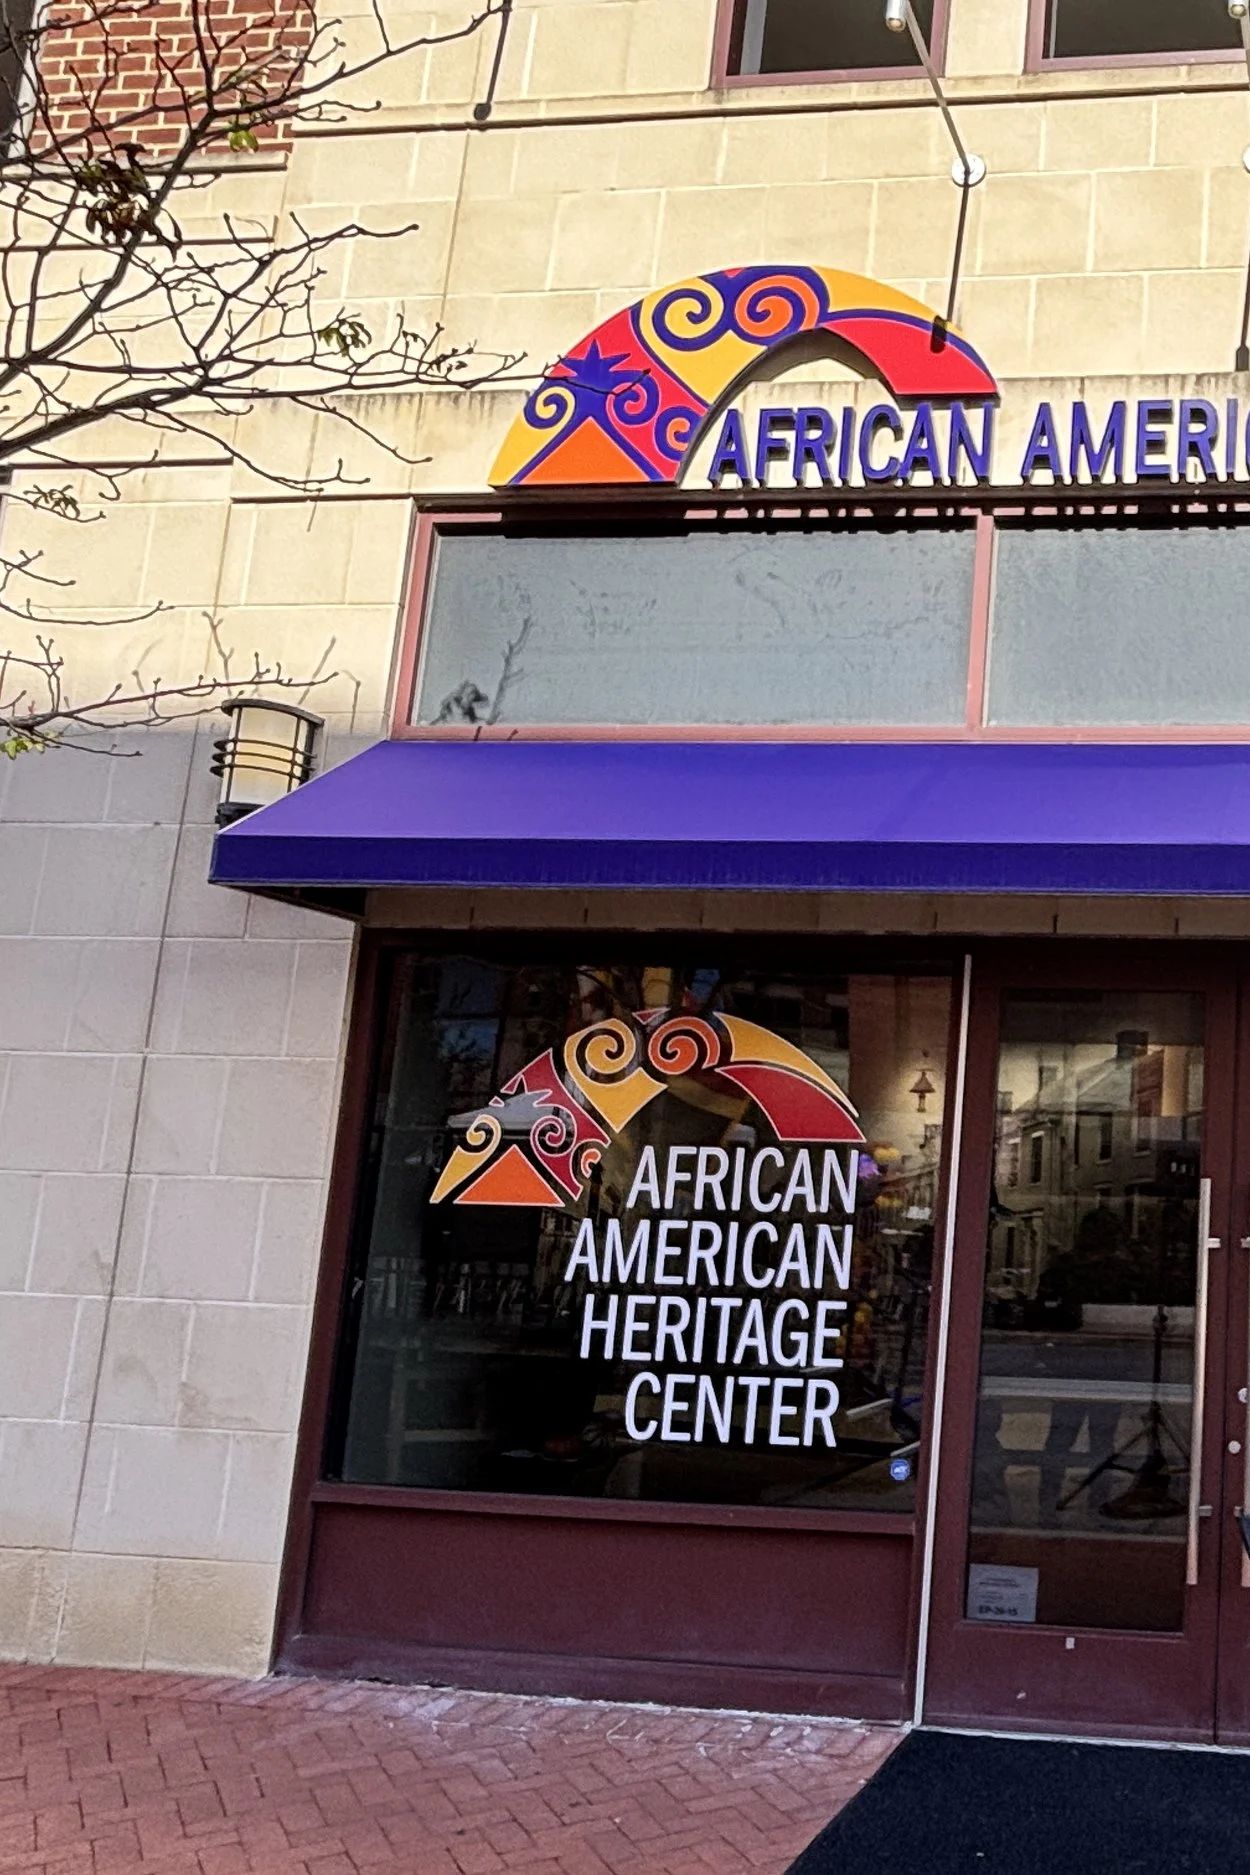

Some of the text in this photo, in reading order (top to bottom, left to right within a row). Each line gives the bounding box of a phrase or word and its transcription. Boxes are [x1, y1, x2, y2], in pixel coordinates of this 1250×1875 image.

[708, 400, 998, 485] AFRICAN
[626, 1145, 859, 1213] AFRICAN
[564, 1218, 853, 1290] AMERICAN
[580, 1293, 847, 1367] HERITAGE
[625, 1371, 839, 1447] CENTER
